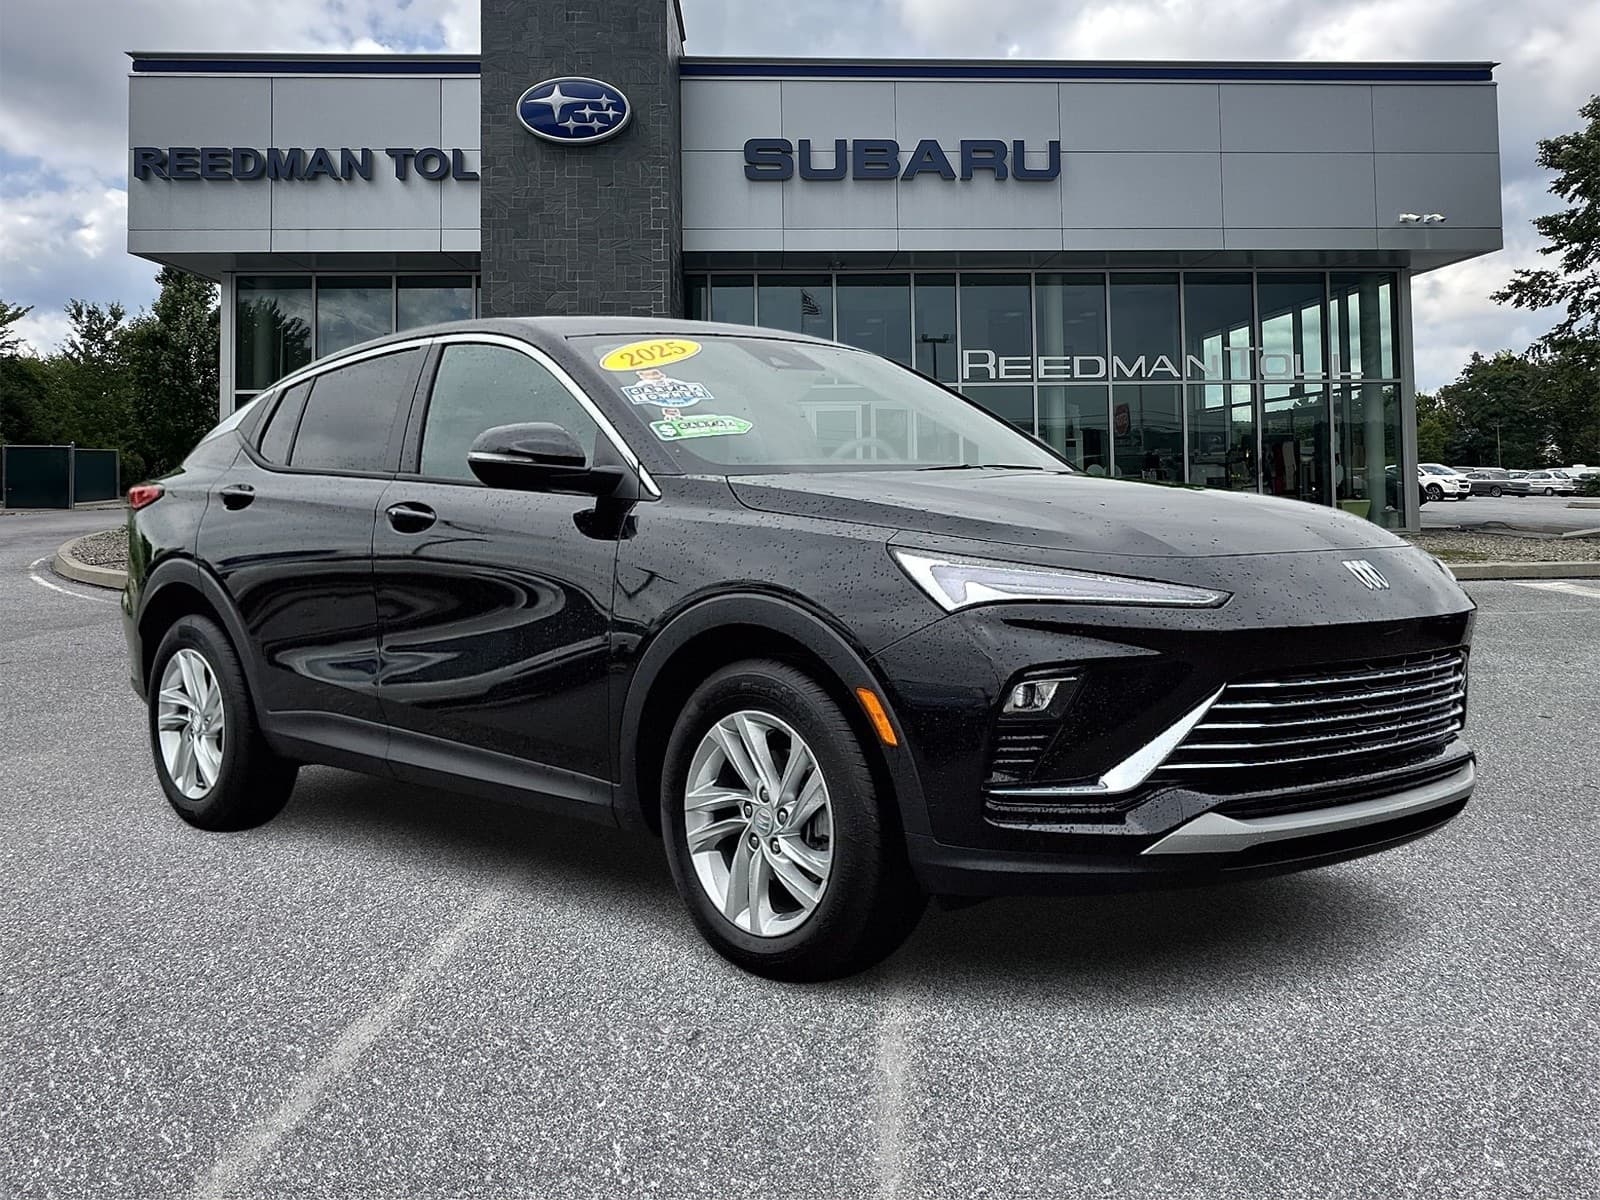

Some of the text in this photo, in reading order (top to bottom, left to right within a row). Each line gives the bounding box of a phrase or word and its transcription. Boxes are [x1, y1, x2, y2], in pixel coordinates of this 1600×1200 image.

[133, 146, 373, 182] REEDMAN
[743, 138, 1061, 181] SUBARU
[619, 341, 687, 368] 2025
[962, 346, 1364, 379] REEDMAN TOLL
